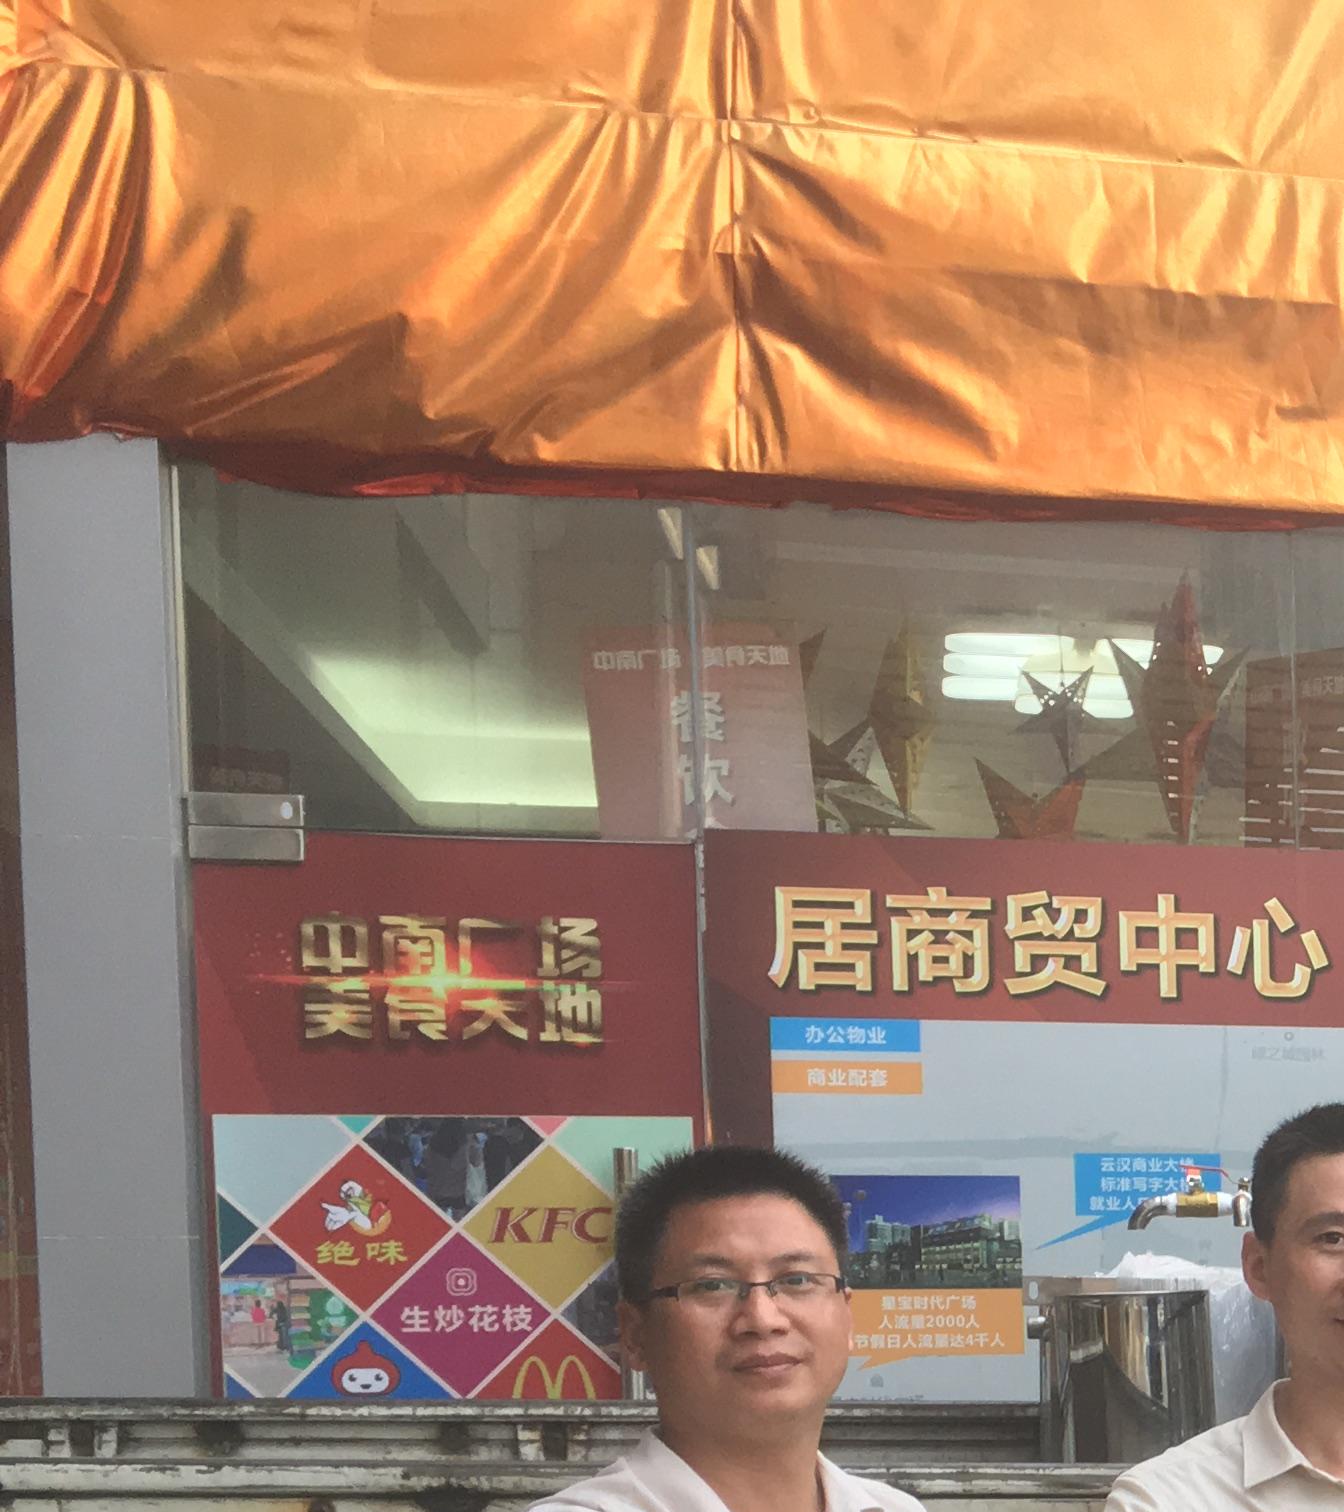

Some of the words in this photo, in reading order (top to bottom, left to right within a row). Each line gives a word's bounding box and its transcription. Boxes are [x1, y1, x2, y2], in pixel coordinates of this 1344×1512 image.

[670, 690, 736, 834] 餐饮
[299, 911, 603, 978] 中南广场
[767, 885, 1331, 999] 居商贸中心
[304, 978, 604, 1043] 美食天地
[805, 1025, 888, 1047] 办公物业
[806, 1068, 889, 1089] 商业配套
[1089, 1196, 1149, 1212] 就业人
[490, 1206, 614, 1245] KFC
[316, 1239, 409, 1266] 绝味
[400, 1304, 533, 1334] 生炒花枝
[878, 1314, 980, 1330] 人流量2000人
[855, 1333, 1005, 1350] 节假日人流量达4千人
